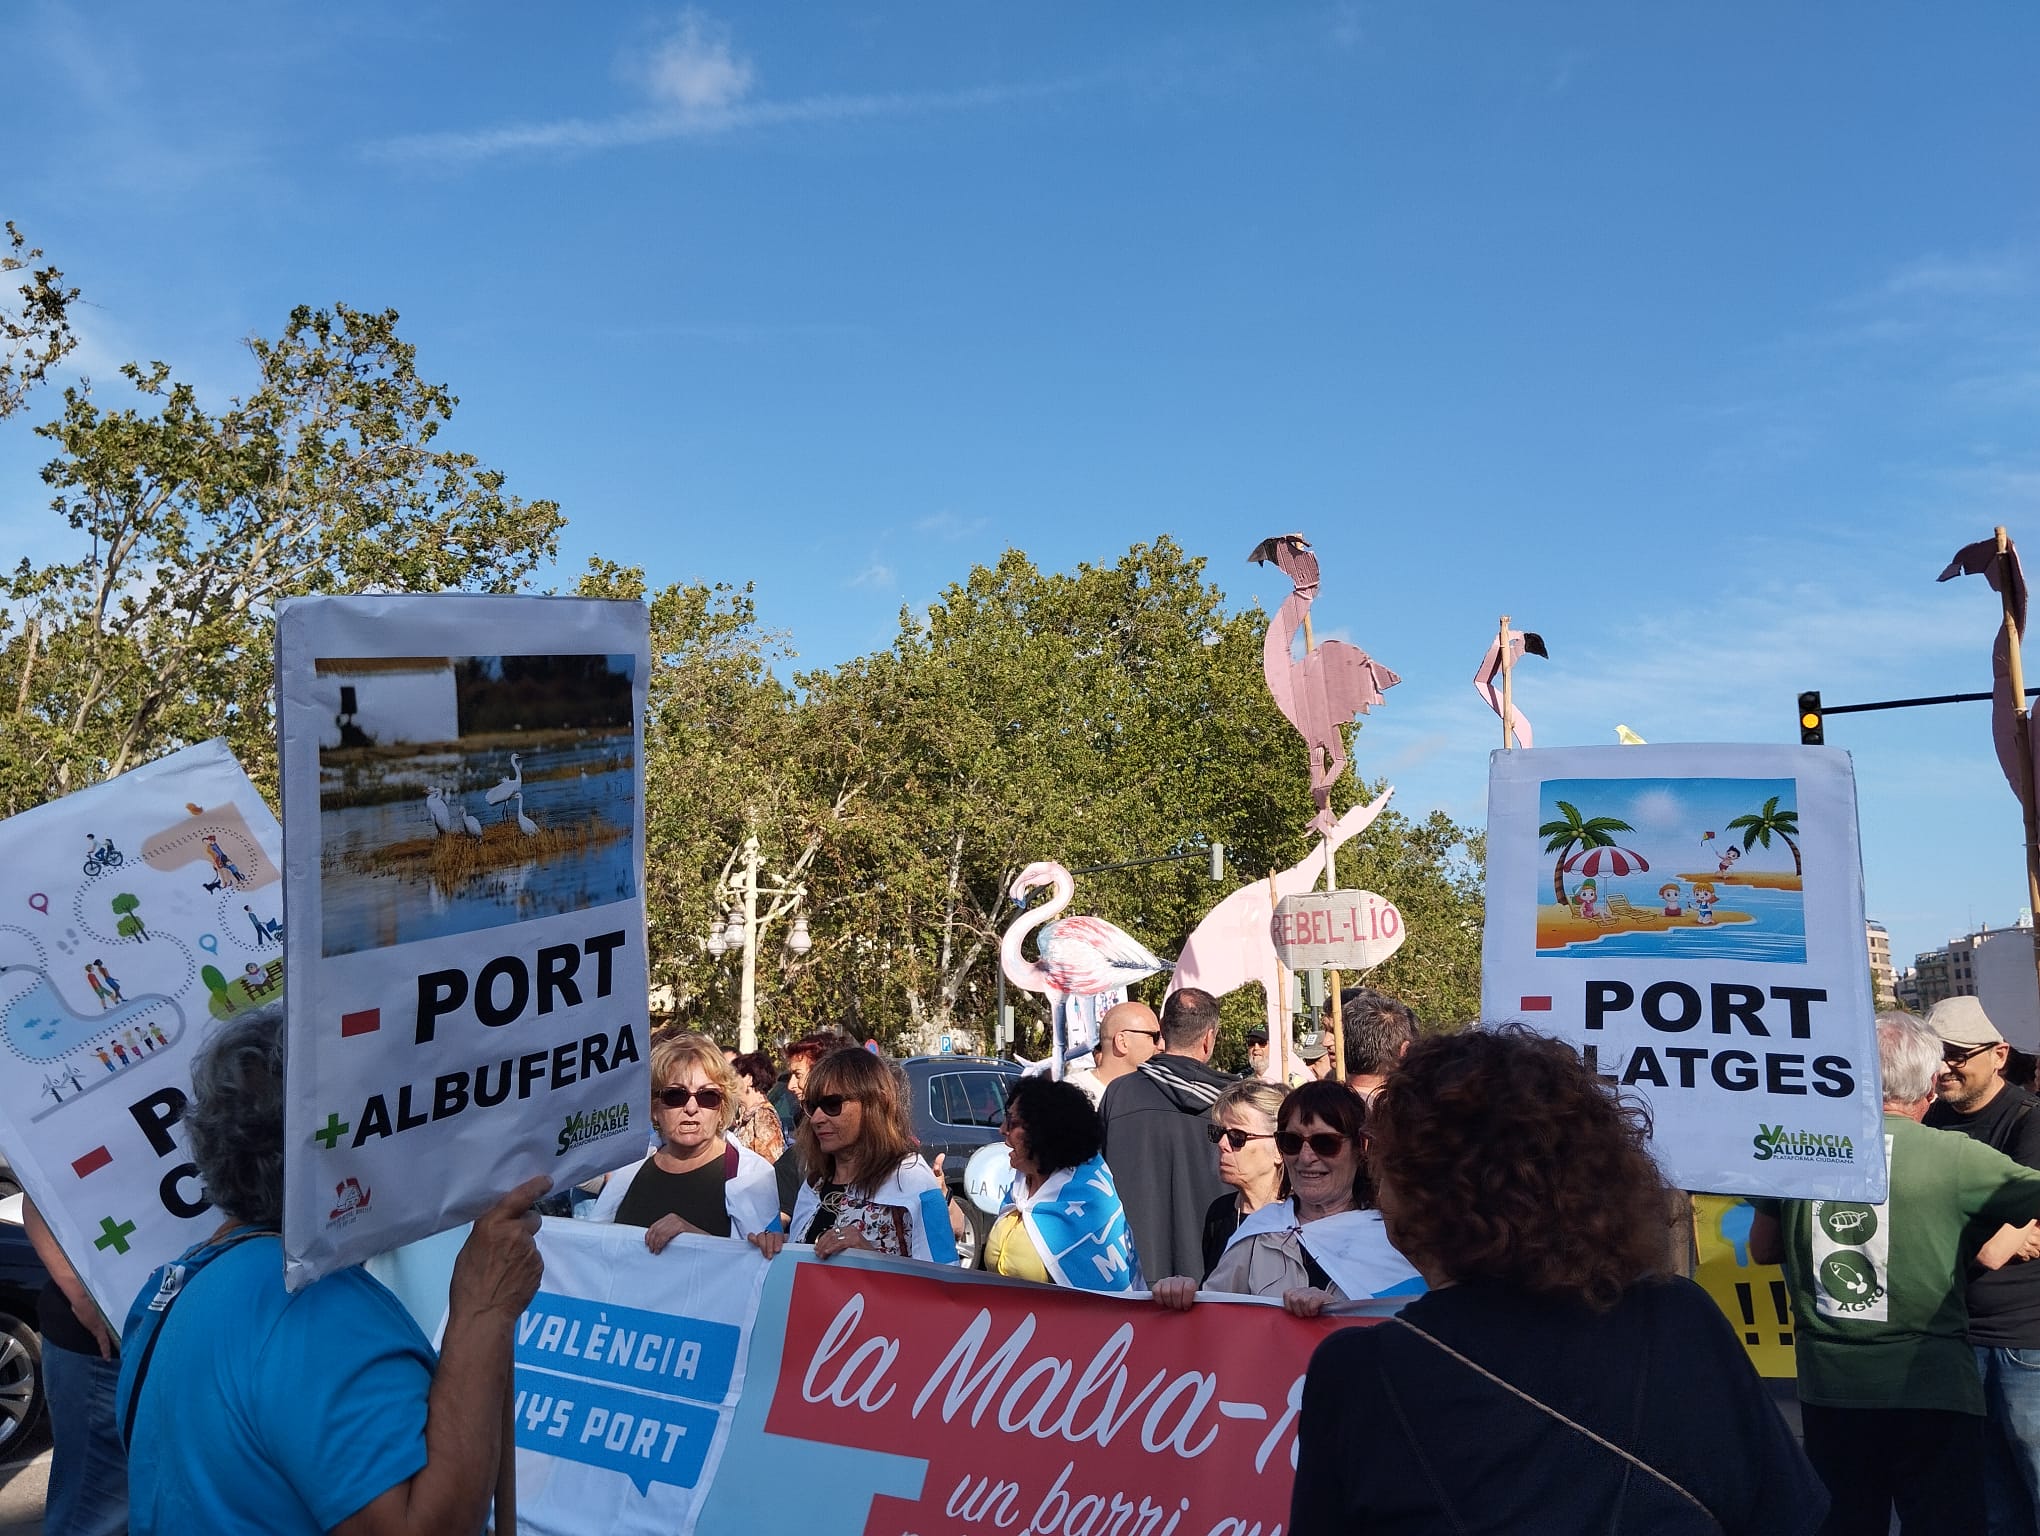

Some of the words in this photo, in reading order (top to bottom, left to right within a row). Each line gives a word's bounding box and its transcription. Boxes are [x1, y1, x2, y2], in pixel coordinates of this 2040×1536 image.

[415, 930, 626, 1045] PORT
[1584, 980, 1828, 1040] PORT
[351, 1023, 640, 1149] ALBUFERA
[1582, 1044, 1856, 1099] LATGES
[555, 1114, 630, 1157] SALUDABLE
[1752, 1134, 1854, 1161] SALUDABLE
[970, 1179, 988, 1196] LA
[1837, 1284, 1885, 1313] AGRO
[517, 1310, 702, 1381] VALÈNCIA
[801, 1292, 899, 1414] la
[579, 1406, 688, 1464] PORT
[945, 1473, 1020, 1528] un
